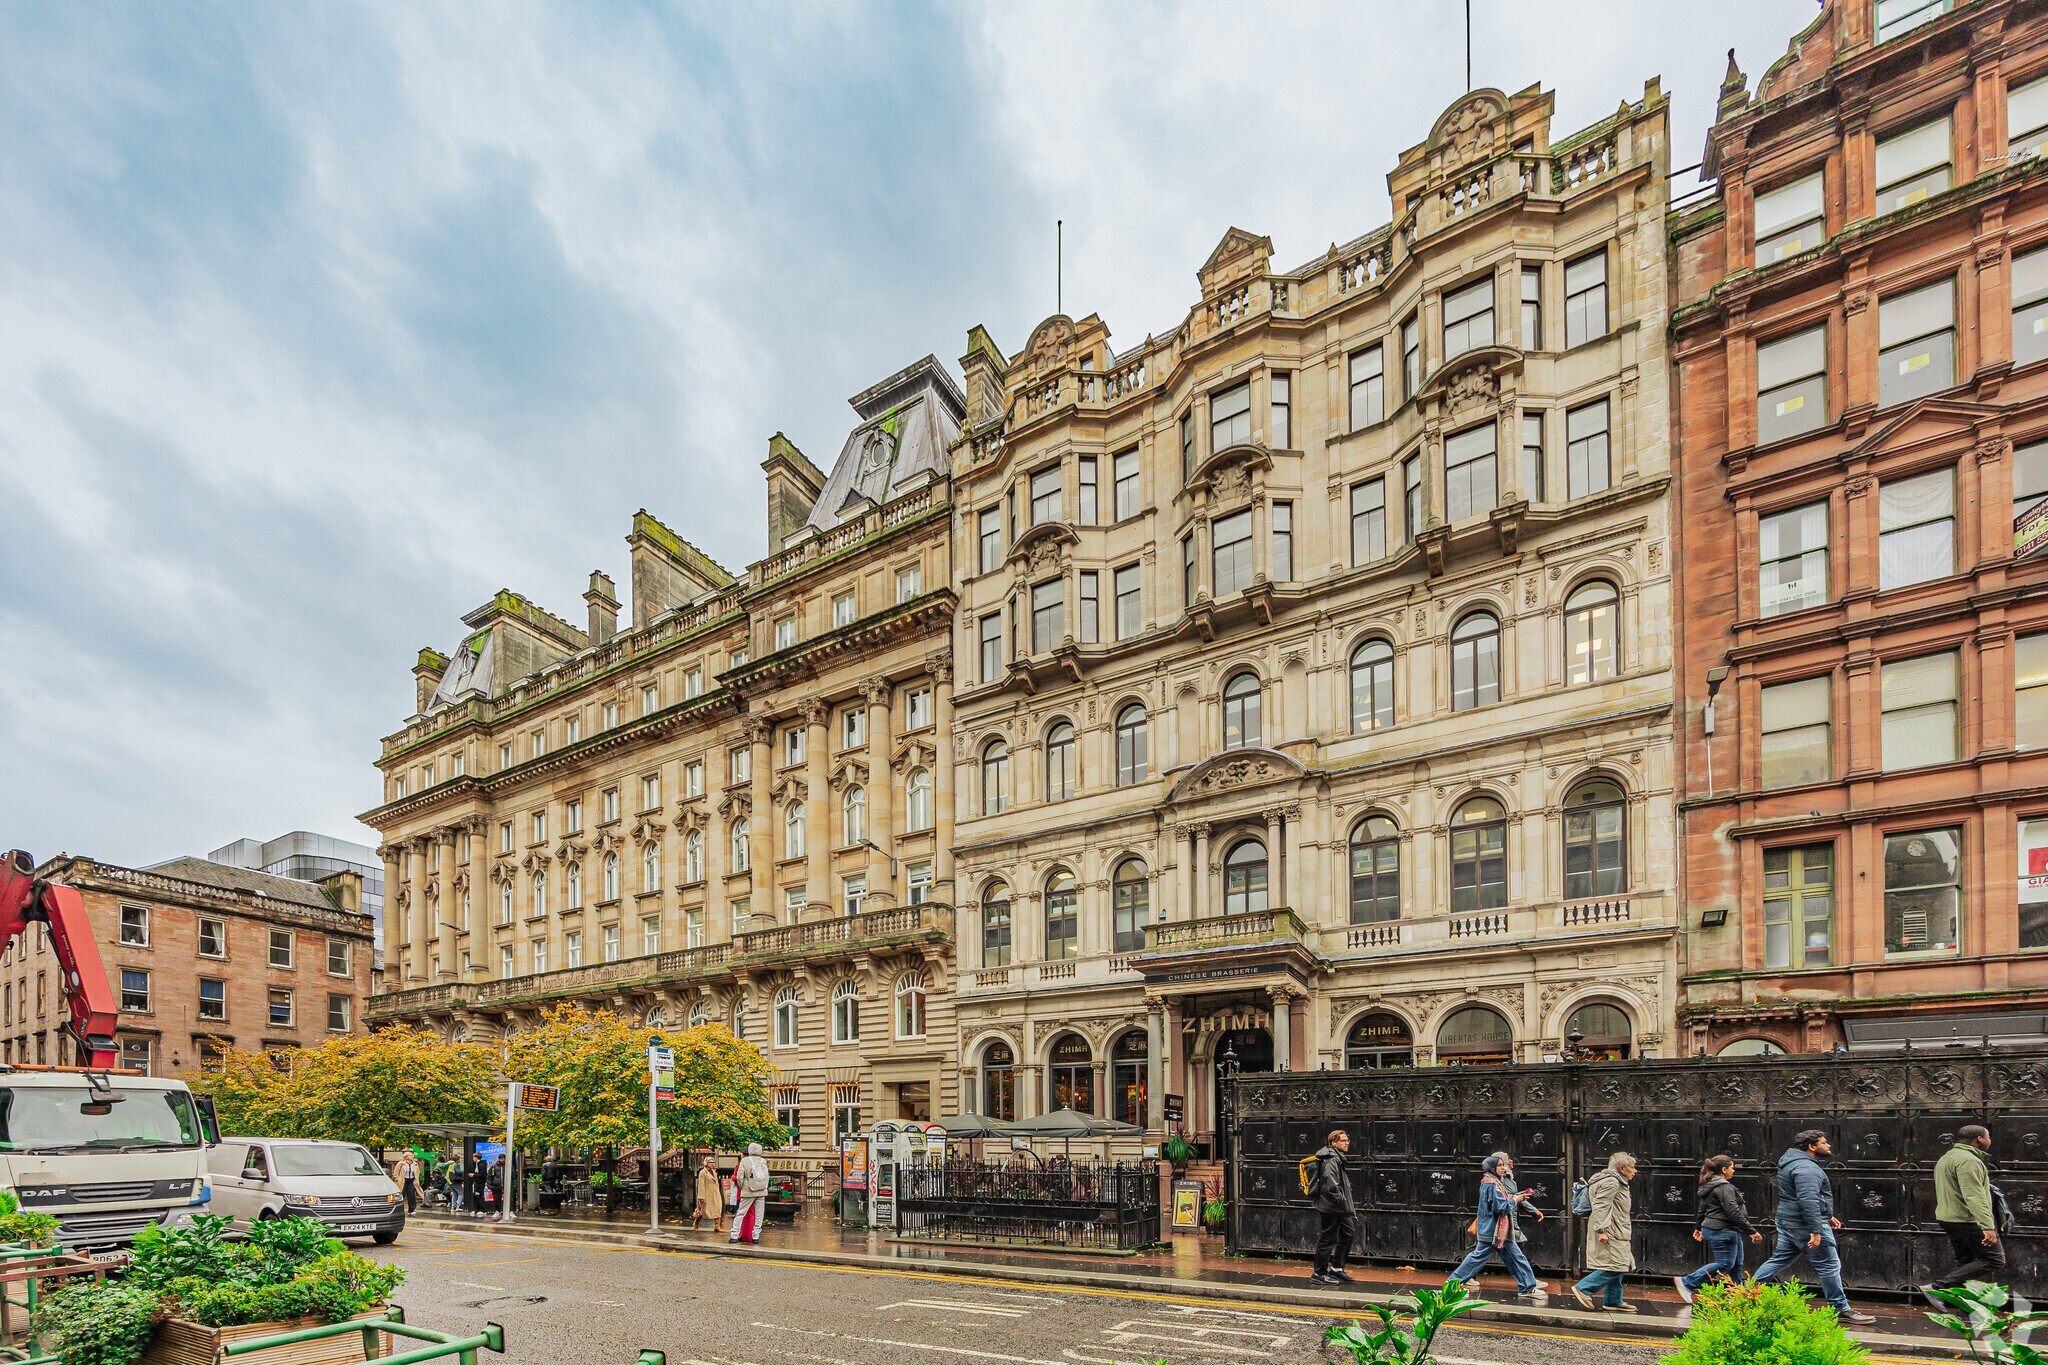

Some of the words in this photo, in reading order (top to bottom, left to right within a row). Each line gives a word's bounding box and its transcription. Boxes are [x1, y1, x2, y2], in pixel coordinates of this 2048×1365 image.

[2022, 521, 2041, 536] For
[2016, 540, 2035, 556] 0141
[1168, 971, 1207, 981] CHINESE
[1211, 967, 1259, 977] BRASSERIE
[1440, 1033, 1478, 1045] LIBERTAS
[1481, 1031, 1509, 1042] HOUSE
[992, 1051, 1010, 1060] 芝麻
[168, 1182, 192, 1190] LF
[21, 1189, 67, 1198] DAF
